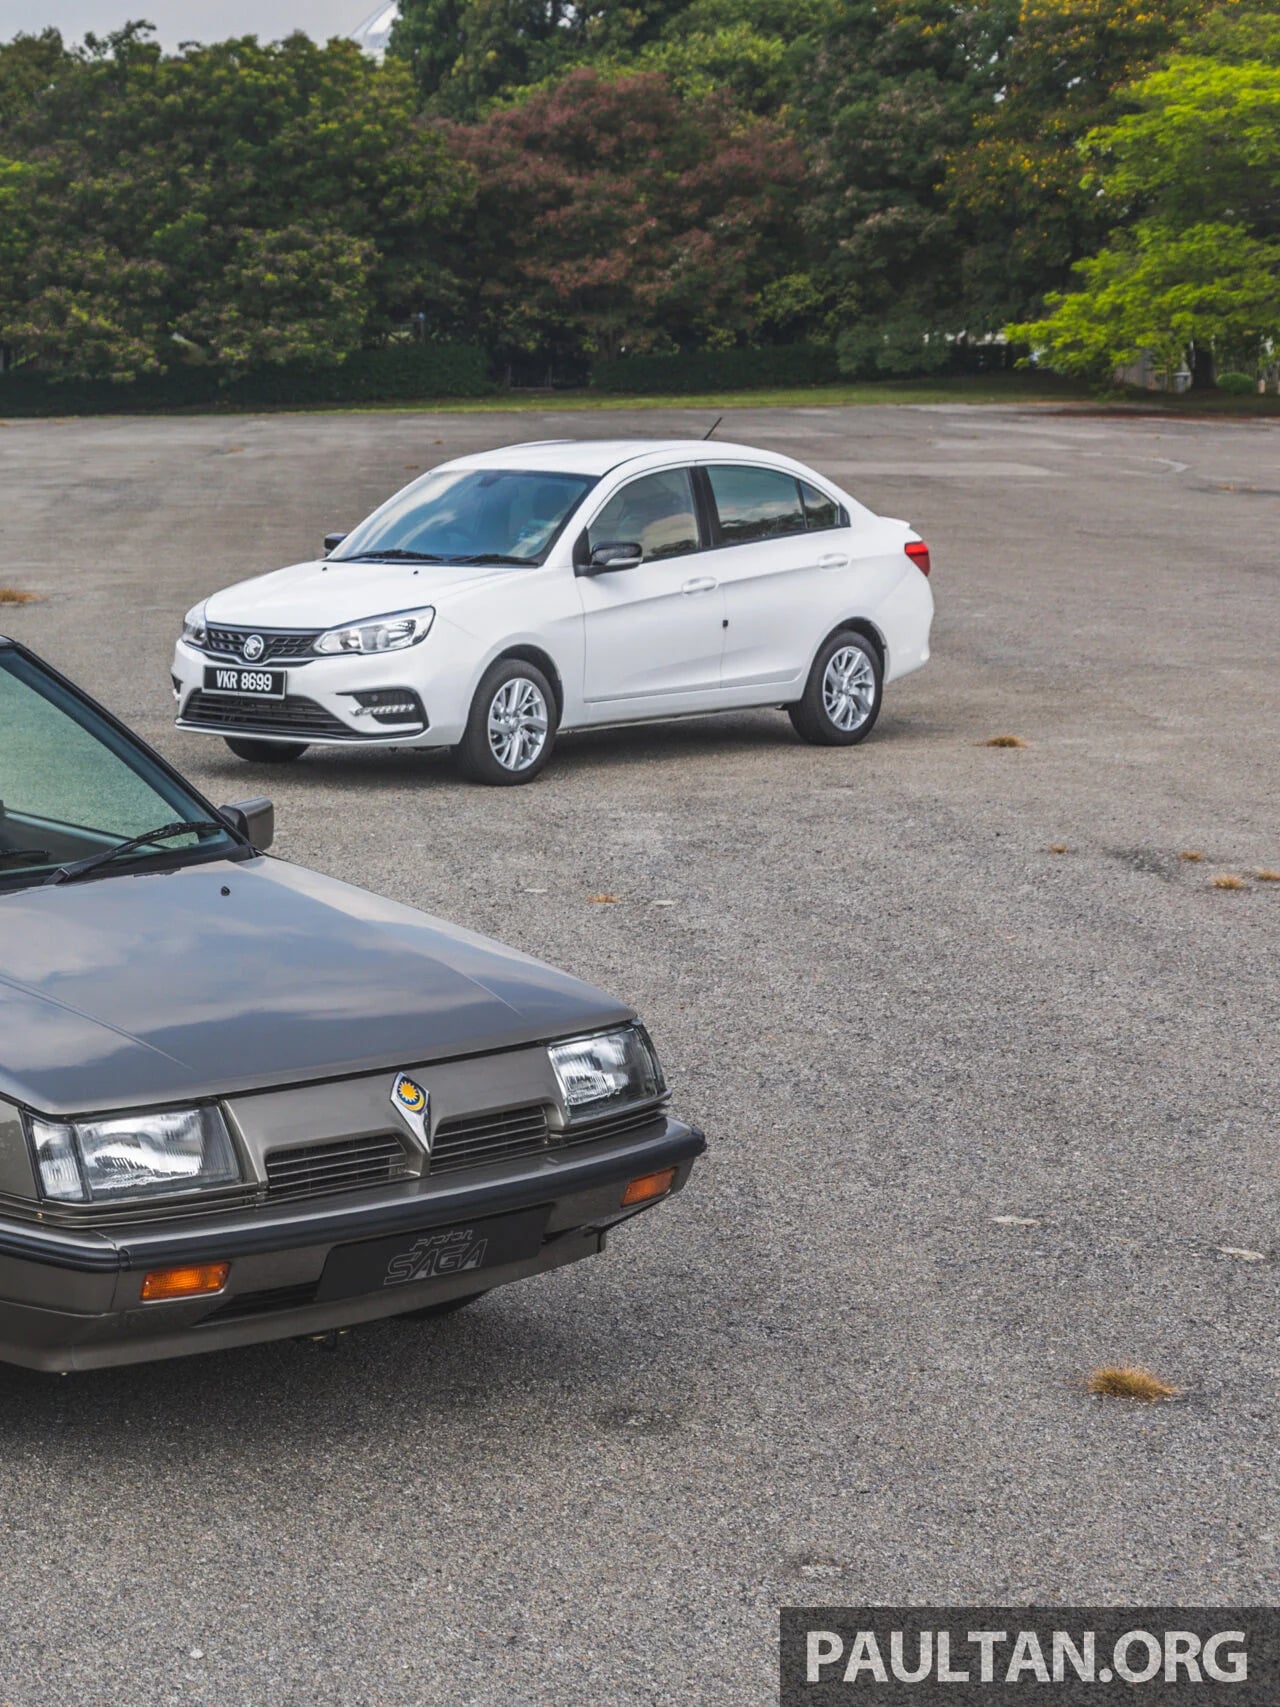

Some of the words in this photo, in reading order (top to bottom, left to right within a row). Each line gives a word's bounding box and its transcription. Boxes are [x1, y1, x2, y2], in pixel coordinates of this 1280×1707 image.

[216, 670, 237, 689] VKR
[240, 672, 272, 692] 8699
[383, 1238, 489, 1286] SAGA
